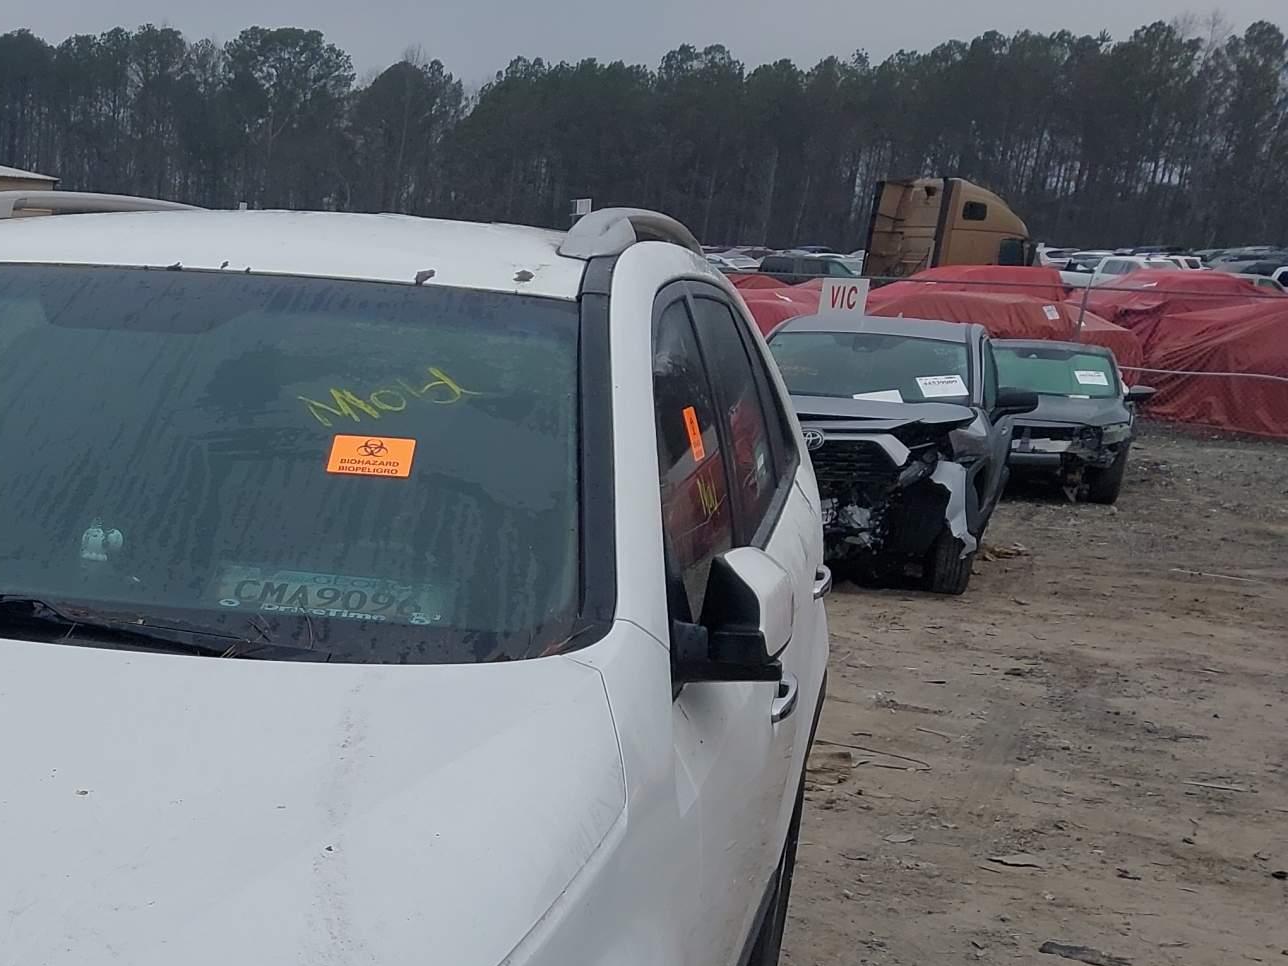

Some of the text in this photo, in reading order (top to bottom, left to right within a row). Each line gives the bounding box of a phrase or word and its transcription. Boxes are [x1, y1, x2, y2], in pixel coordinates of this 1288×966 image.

[831, 285, 858, 309] VIC
[340, 458, 400, 468] BIOHAZARD
[338, 465, 398, 475] BIOPELIGRO
